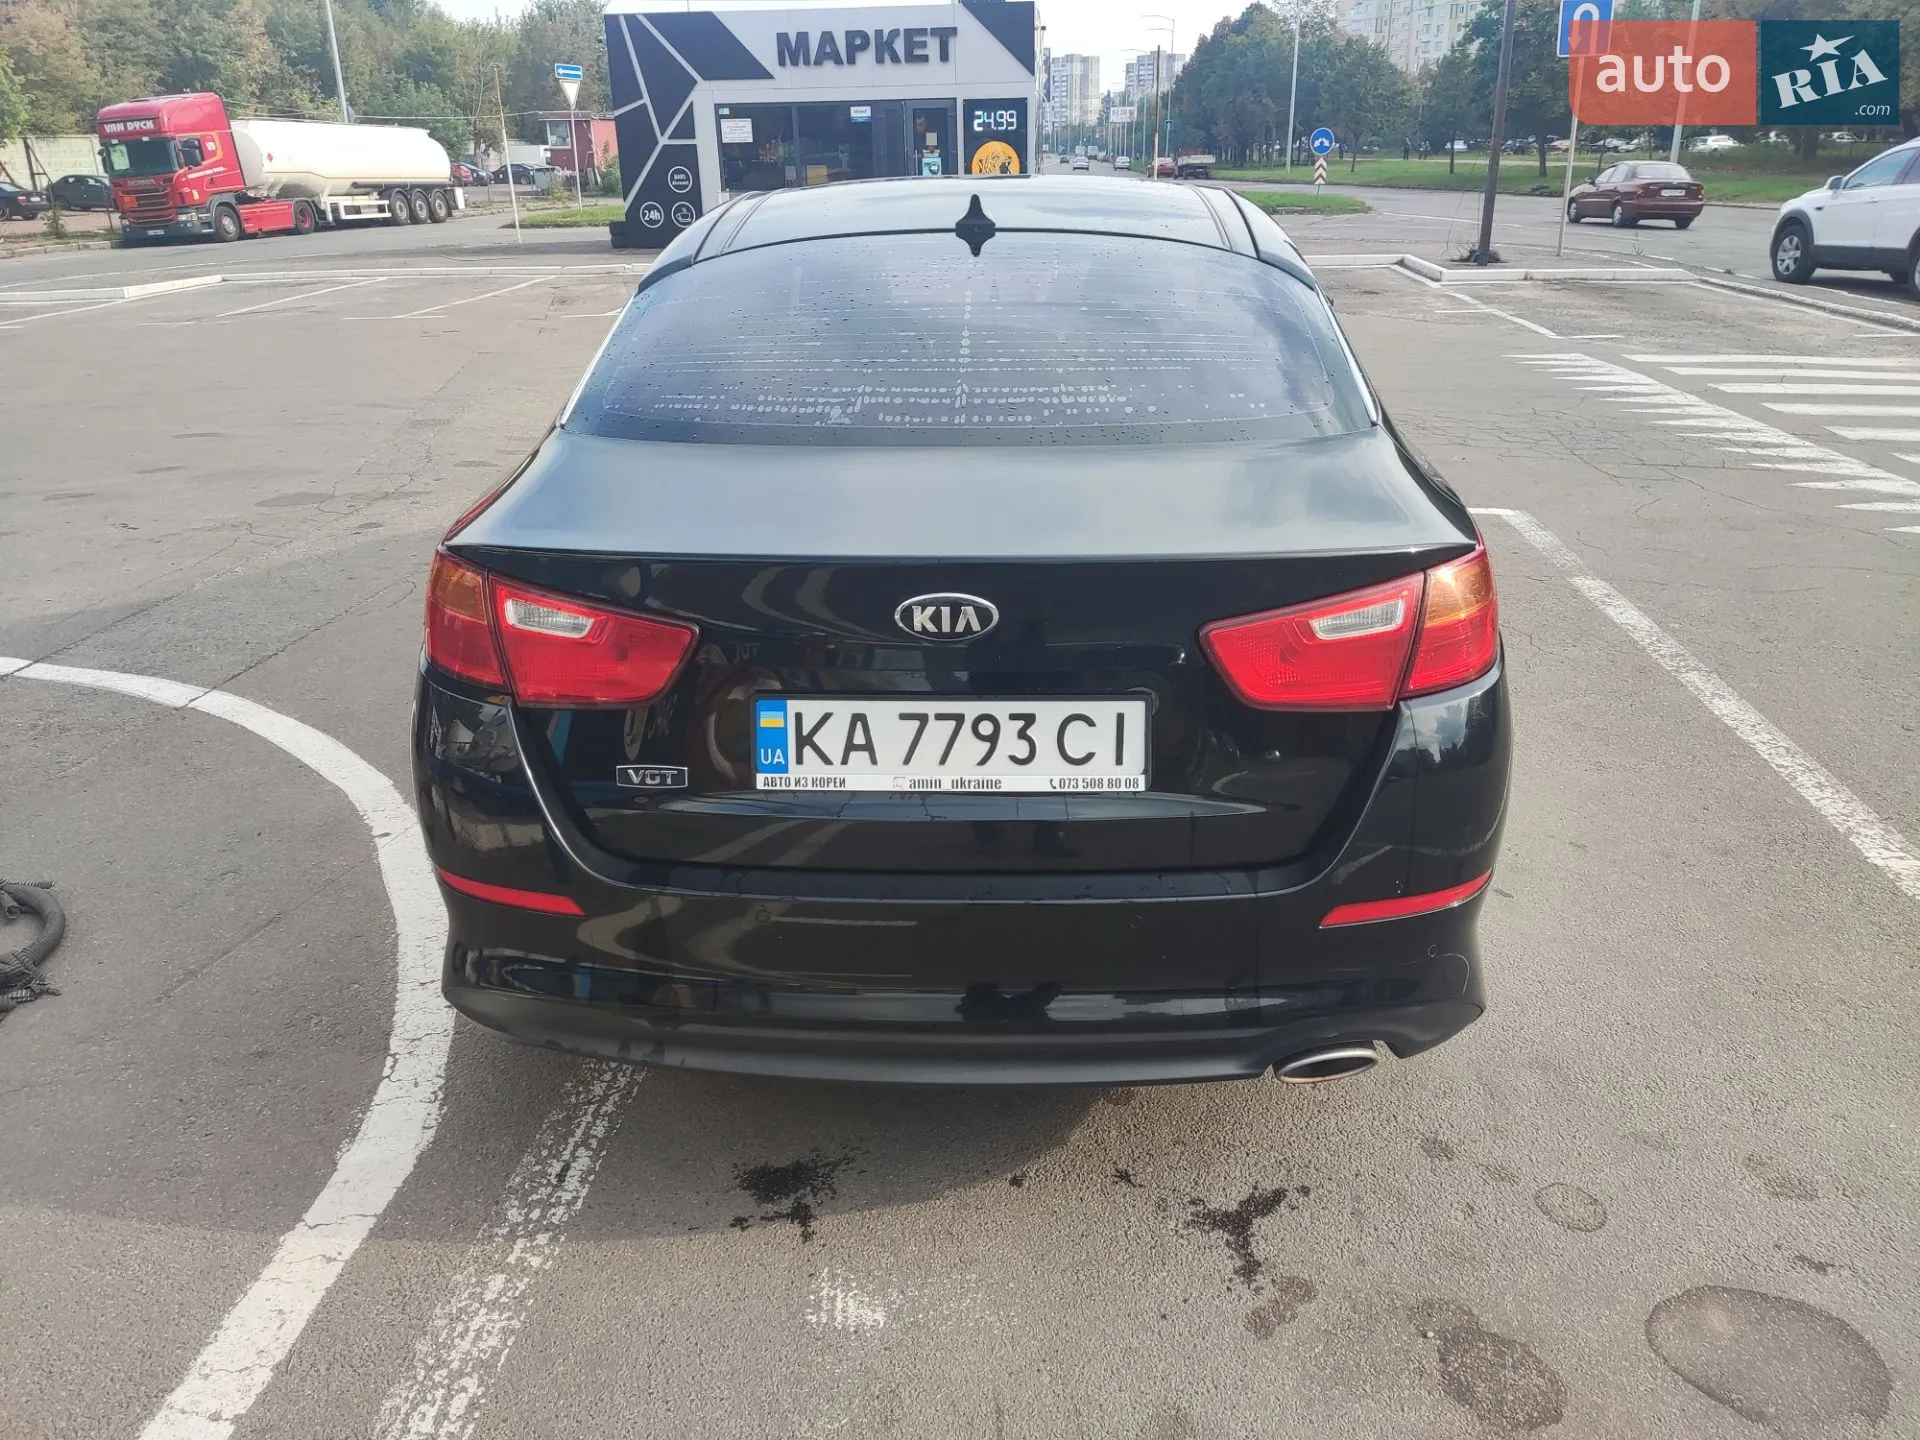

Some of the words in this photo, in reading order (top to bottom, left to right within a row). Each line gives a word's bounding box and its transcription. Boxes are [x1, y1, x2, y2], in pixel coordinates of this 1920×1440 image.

[776, 26, 958, 67] МАРКЕТ
[104, 122, 125, 133] VAN
[127, 120, 154, 131] DYCK
[973, 110, 1018, 132] 24.99
[643, 210, 661, 220] 24h
[912, 605, 982, 633] KIA
[794, 711, 878, 767] KA
[898, 711, 1037, 767] 7793
[1056, 711, 1125, 767] CI
[760, 748, 785, 766] UA
[626, 769, 678, 785] VGT
[763, 776, 791, 788] АВТО
[794, 776, 808, 788] ИЗ
[811, 776, 846, 788] КОРЕИ
[908, 776, 1002, 790] amin_ukraine
[1059, 777, 1079, 789] 073
[1082, 777, 1104, 789] 508
[1107, 777, 1121, 789] 80
[1124, 777, 1139, 789] 08
